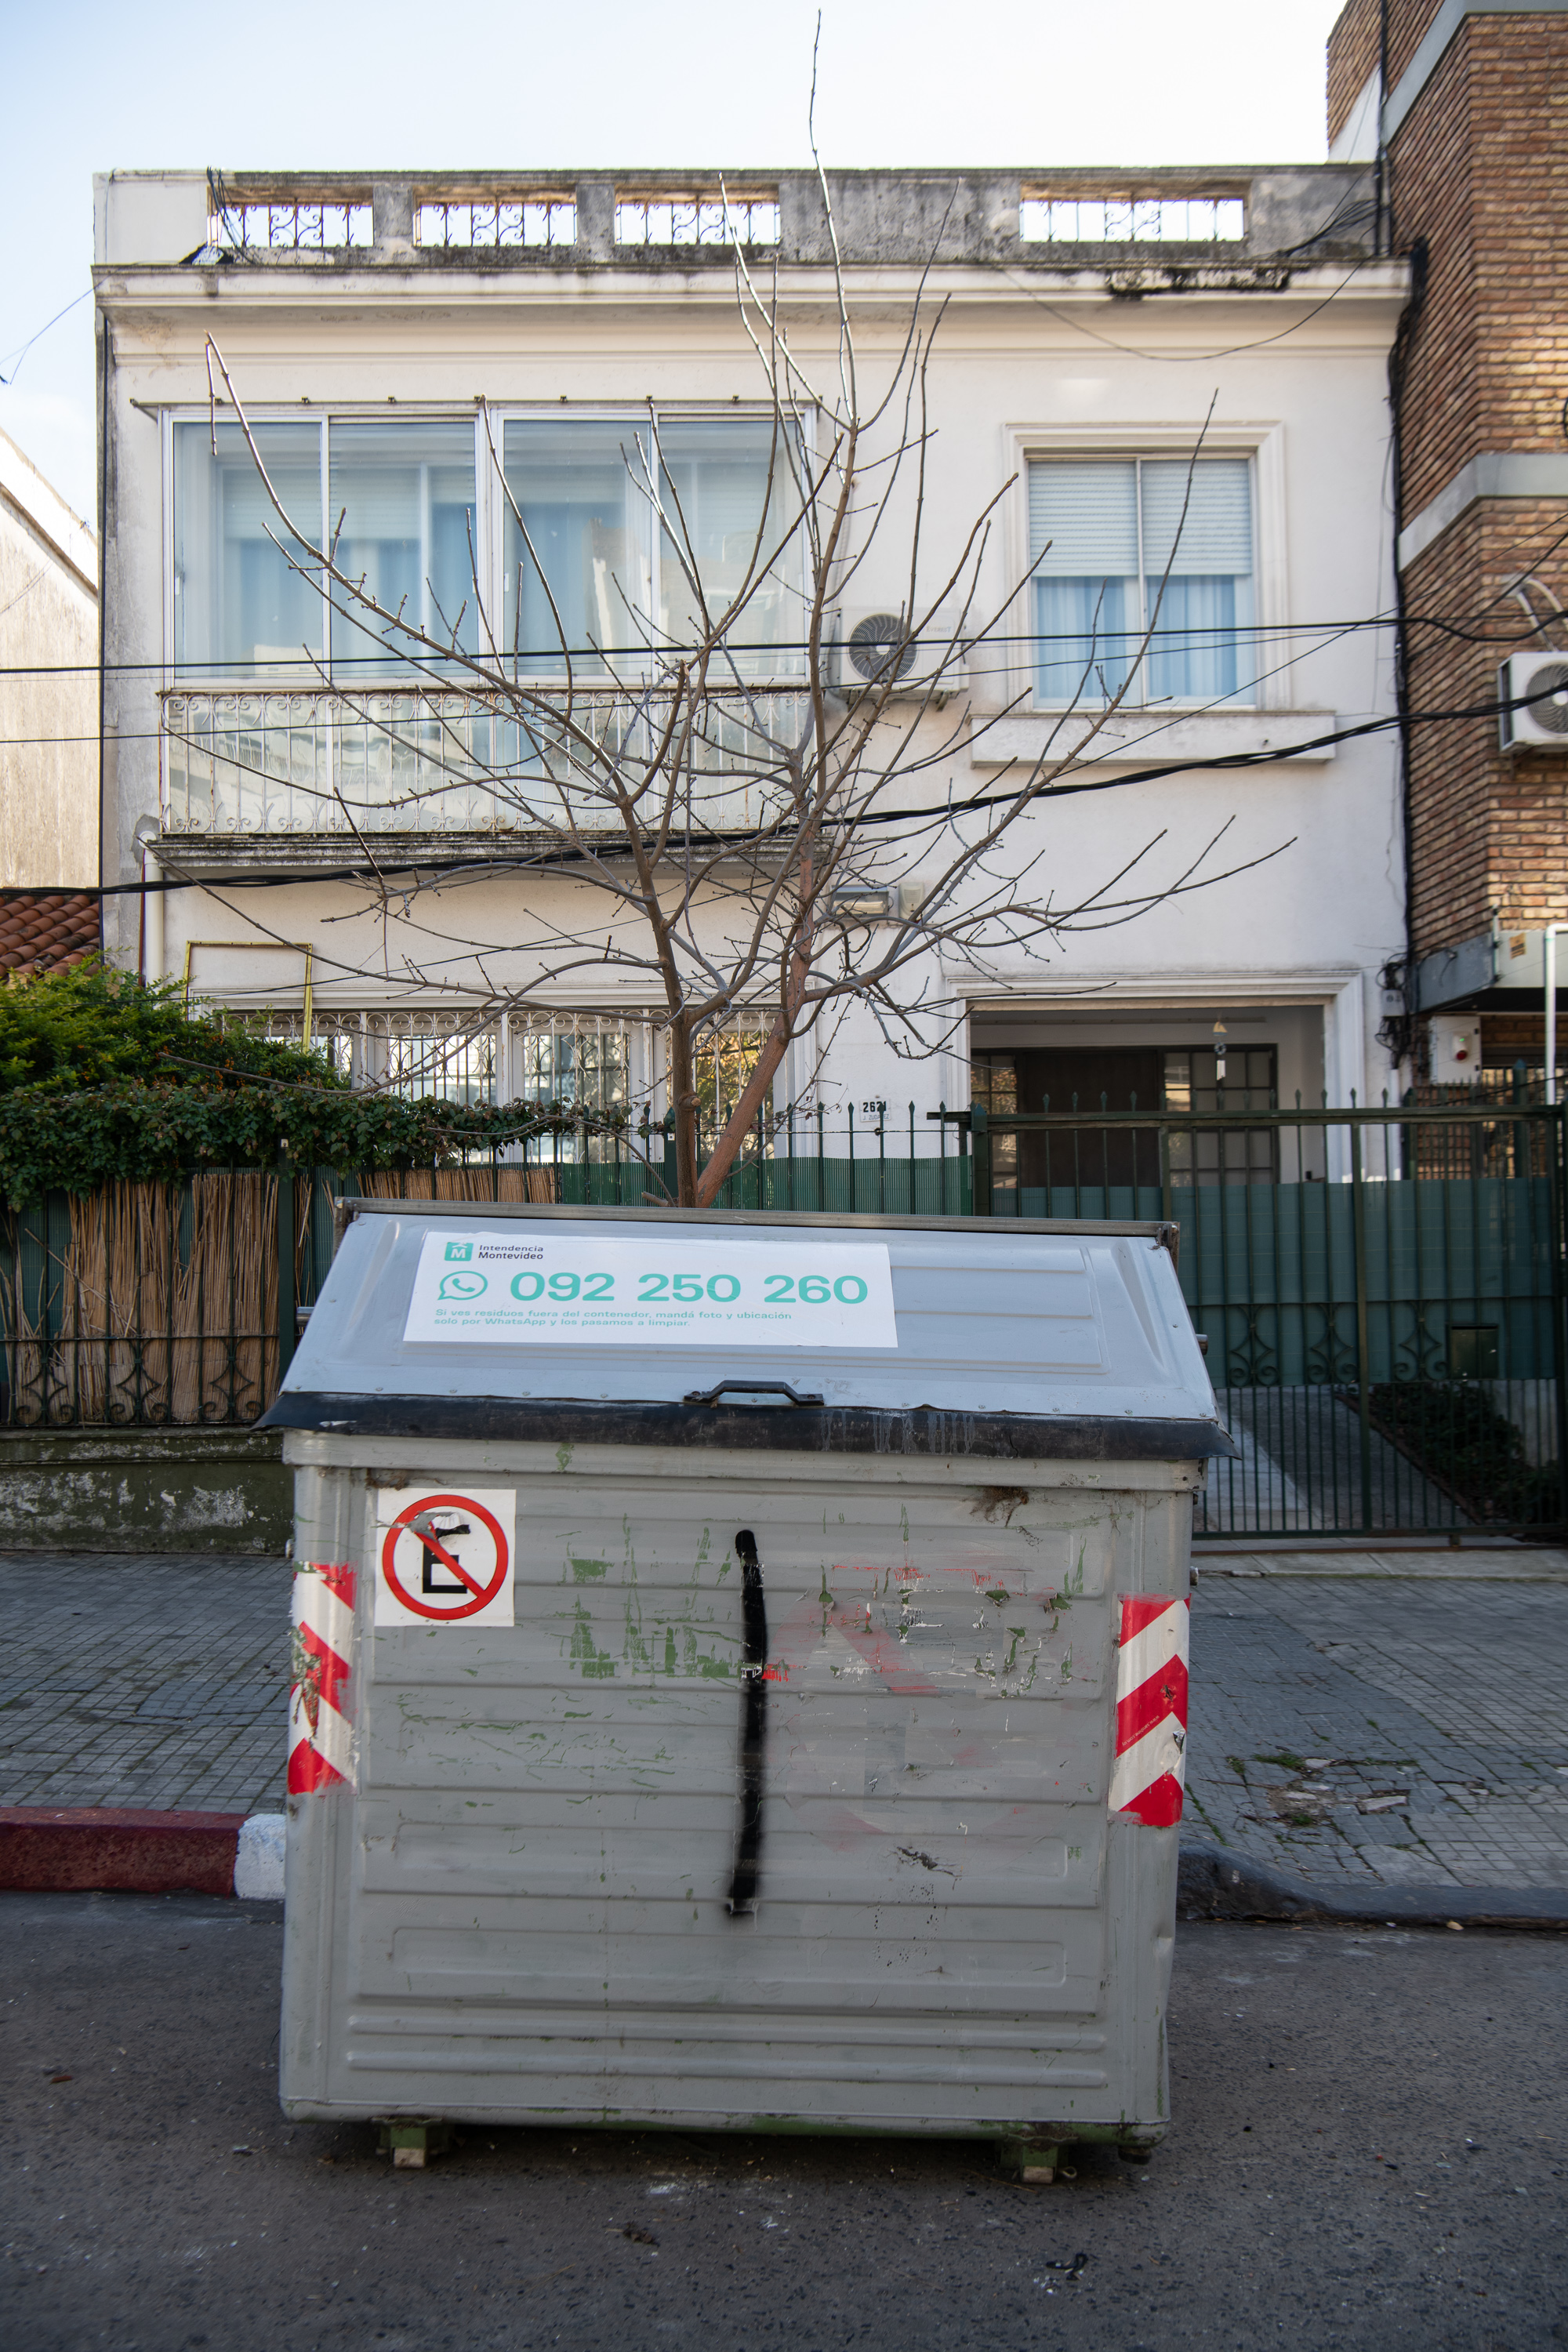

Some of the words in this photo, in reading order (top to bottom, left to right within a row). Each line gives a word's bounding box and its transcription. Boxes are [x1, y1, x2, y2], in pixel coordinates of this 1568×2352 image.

[510, 1272, 615, 1301] 092
[637, 1273, 742, 1302] 250
[764, 1275, 869, 1305] 260
[583, 1310, 652, 1319] contenedor,
[485, 1318, 546, 1327] WhatsApp
